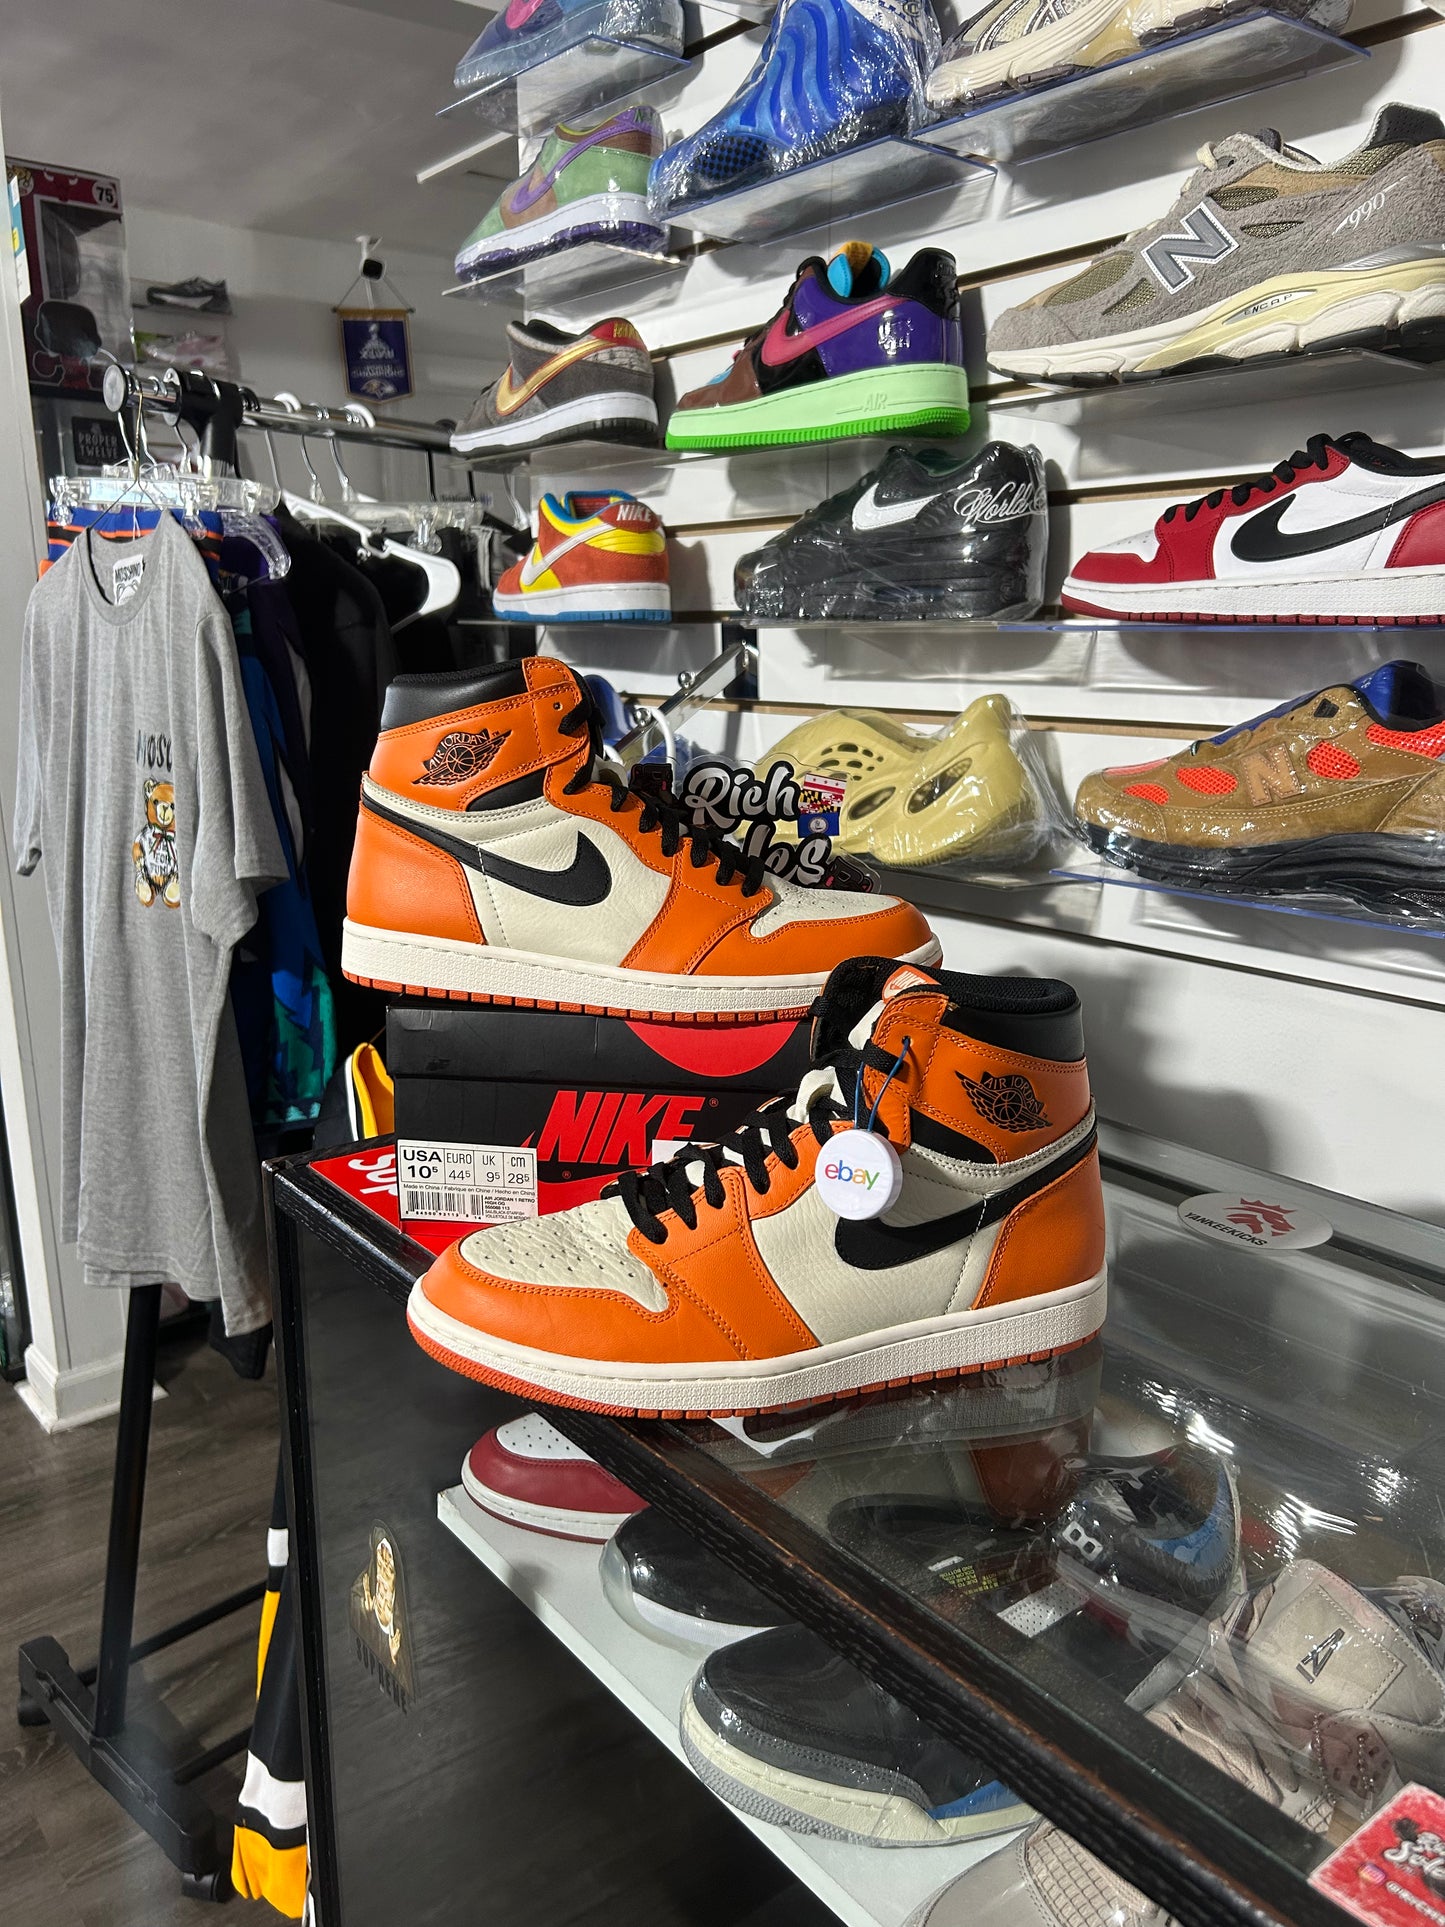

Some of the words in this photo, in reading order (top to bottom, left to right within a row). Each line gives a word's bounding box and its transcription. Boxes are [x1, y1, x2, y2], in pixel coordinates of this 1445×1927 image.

[96, 186, 114, 204] 75
[1141, 201, 1239, 295] N
[864, 392, 888, 412] AIR
[616, 503, 651, 522] NIKE
[428, 750, 445, 769] AIR
[441, 731, 488, 750] JORDAN
[684, 765, 796, 830] Rich
[983, 1077, 1007, 1089] AIR
[1010, 1076, 1041, 1114] JORDAN
[537, 1090, 706, 1167] NIKE
[403, 1149, 442, 1162] USA
[446, 1152, 472, 1165] EURO
[482, 1155, 496, 1166] UK
[511, 1156, 526, 1168] cm
[444, 1185, 467, 1193] Fabrique
[825, 1160, 880, 1191] ebay
[1185, 1212, 1268, 1246] YANKEEKICKS
